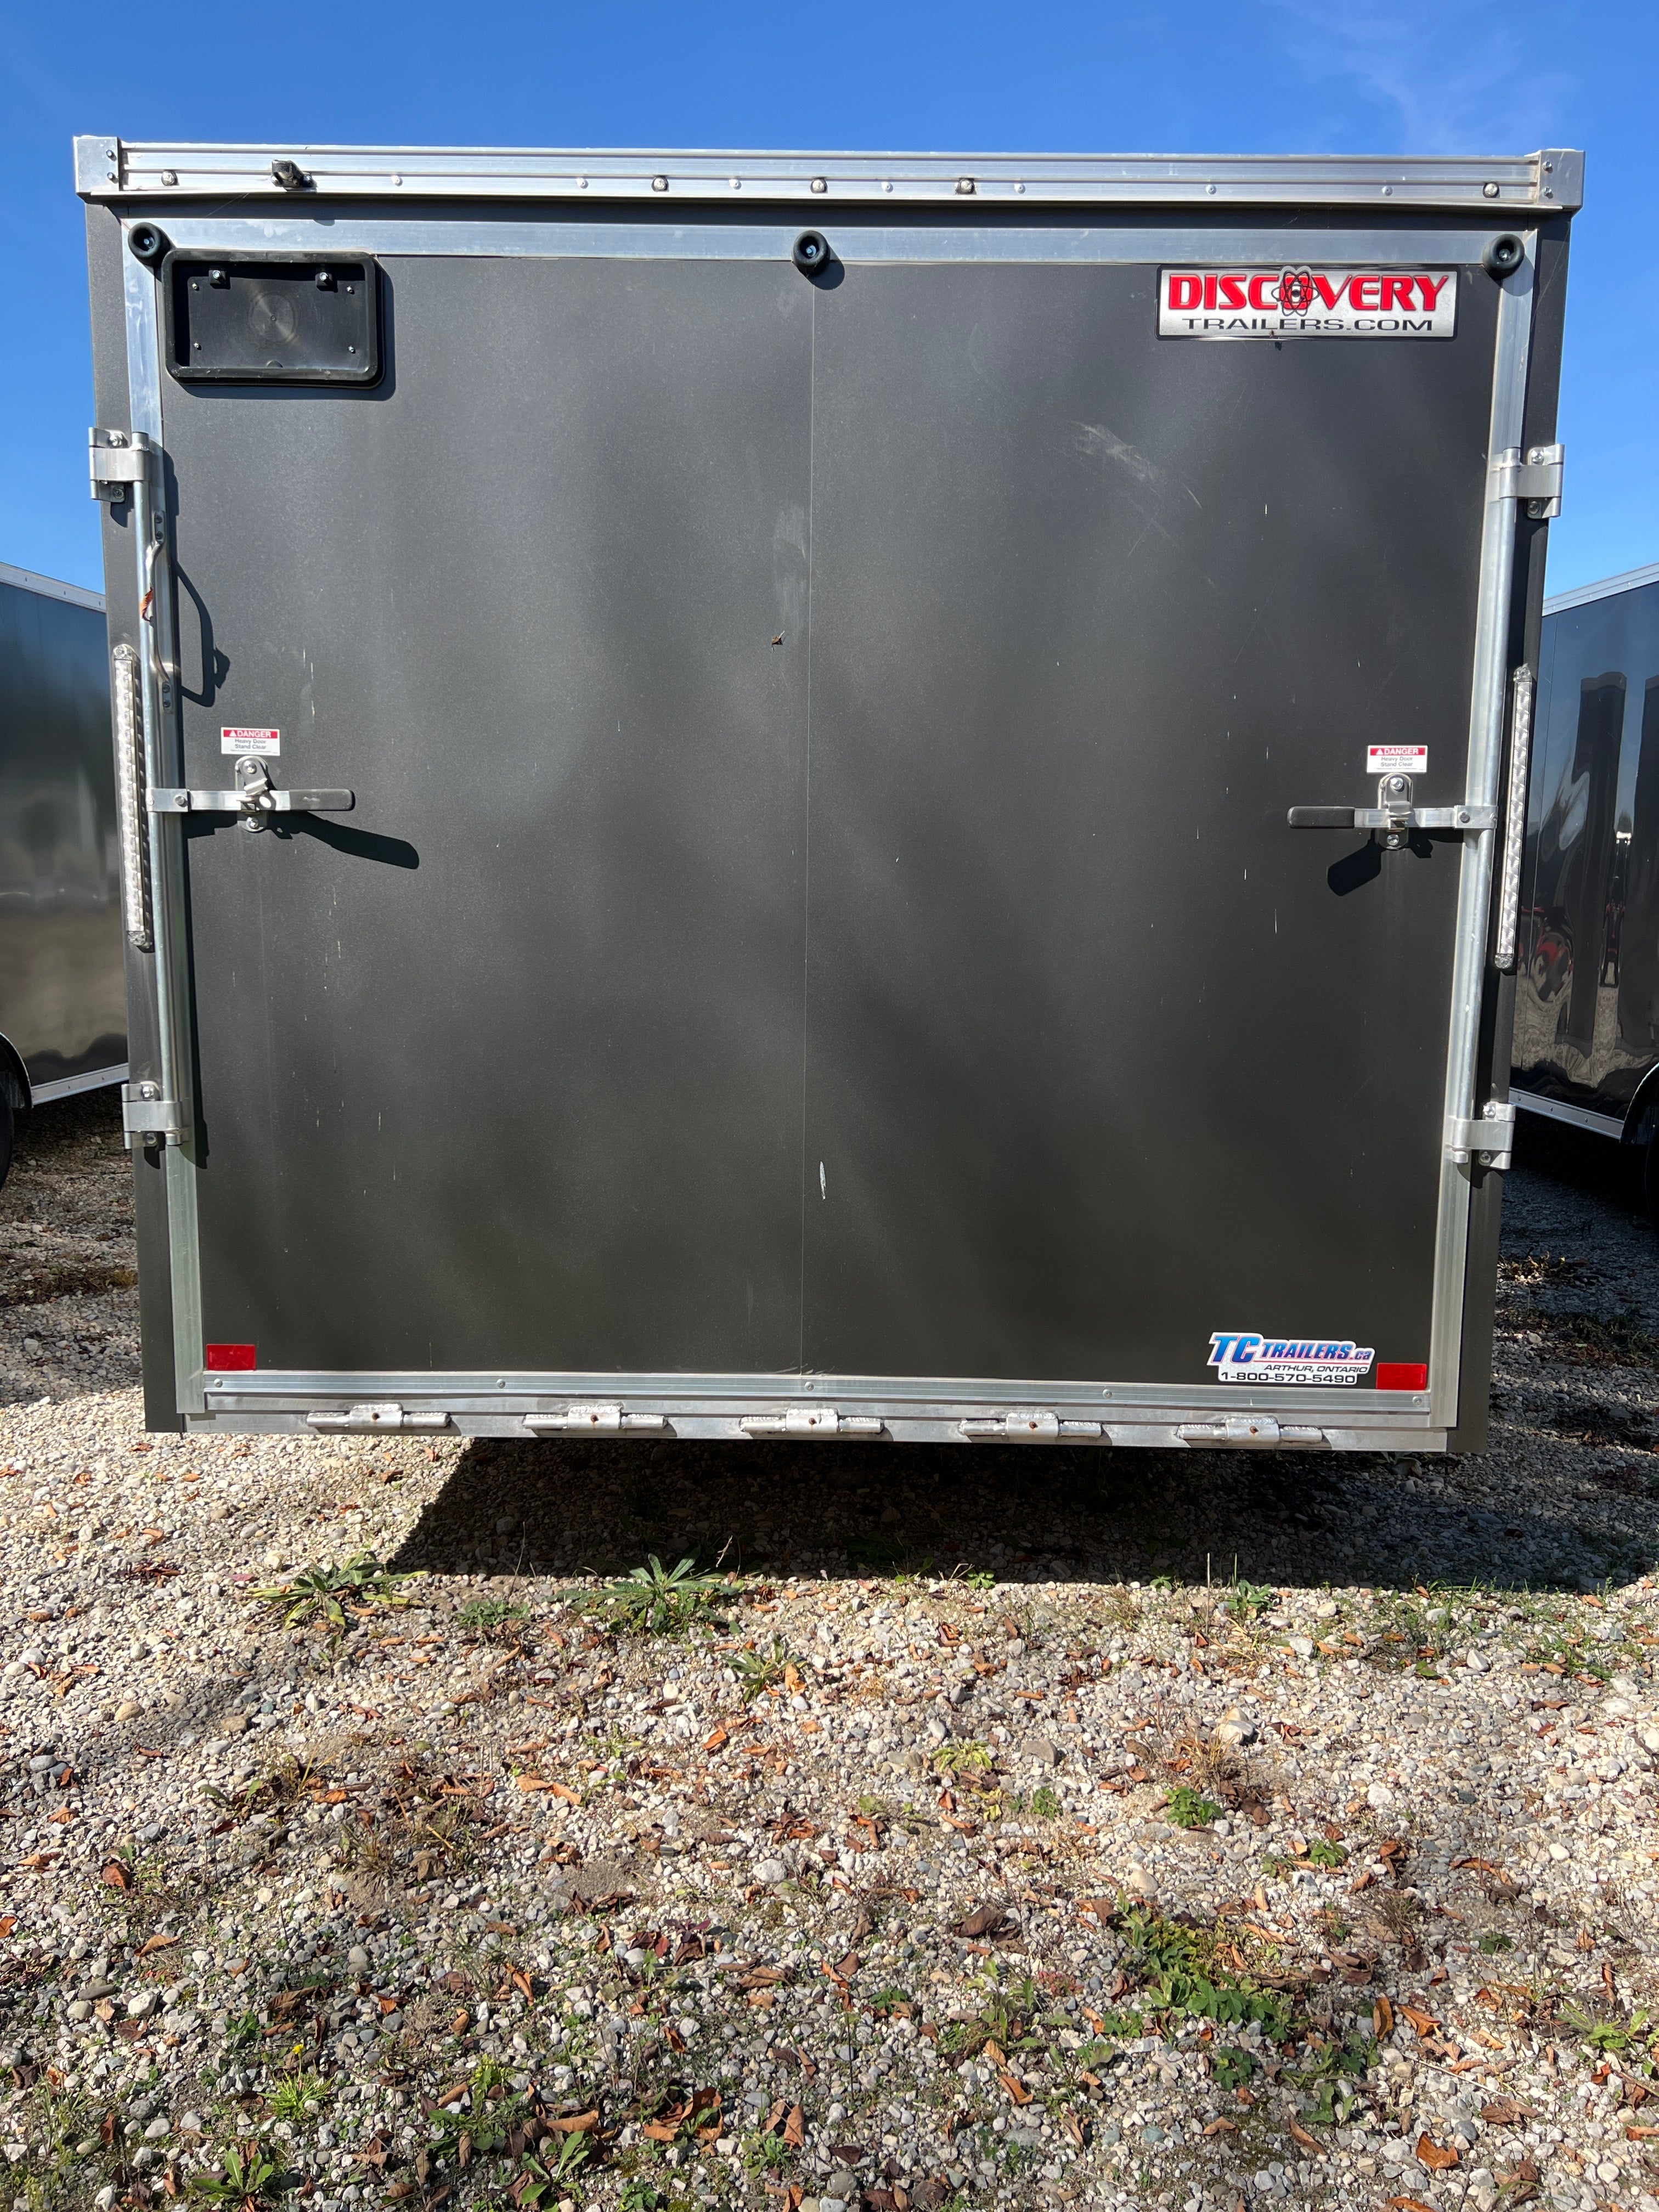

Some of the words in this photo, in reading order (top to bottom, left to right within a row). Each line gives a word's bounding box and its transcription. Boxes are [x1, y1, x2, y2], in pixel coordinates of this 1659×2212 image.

[1169, 274, 1449, 311] DISCOVERY
[1182, 318, 1432, 331] TRAILERS.COM
[236, 730, 272, 738] DANGER
[1263, 1364, 1314, 1373] ARTHUR,
[1221, 1372, 1356, 1383] 1-800-570-5490
